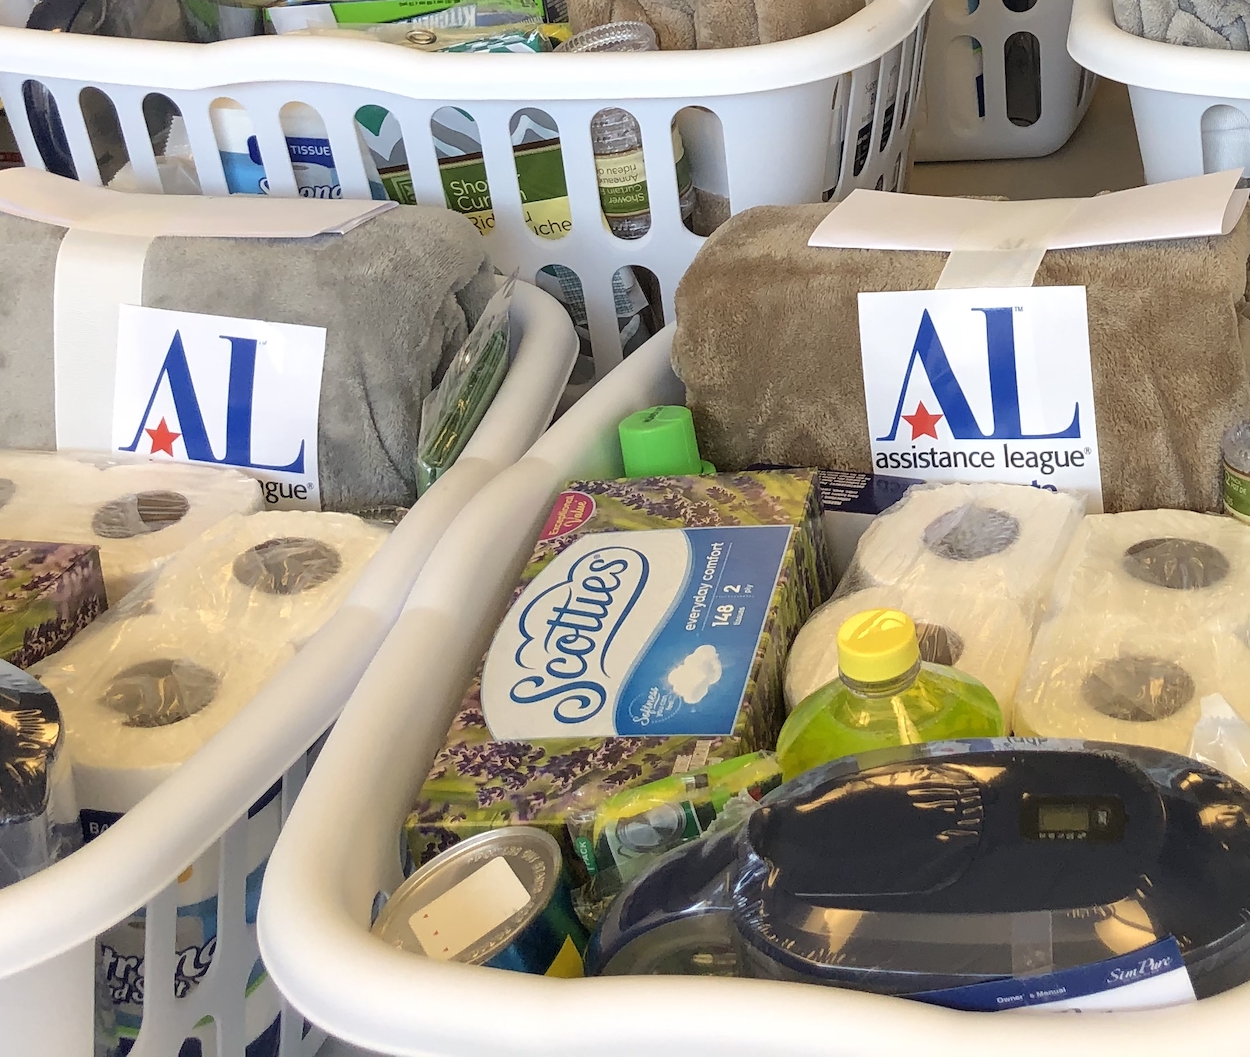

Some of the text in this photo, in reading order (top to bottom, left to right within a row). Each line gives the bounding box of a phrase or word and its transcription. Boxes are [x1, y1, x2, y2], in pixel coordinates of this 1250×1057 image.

[289, 144, 332, 157] TISSUE
[606, 164, 637, 175] rideau
[599, 174, 638, 184] Anneaux
[612, 185, 643, 195] Curtain
[608, 193, 645, 204] Shower
[876, 445, 995, 469] assistance
[549, 493, 575, 537] Exceptional
[564, 499, 587, 529] Value
[685, 542, 725, 631] everyday comfort
[744, 584, 754, 594] ply
[712, 584, 741, 628] 148 2
[632, 686, 660, 727] Softness
[1036, 985, 1067, 998] Manual
